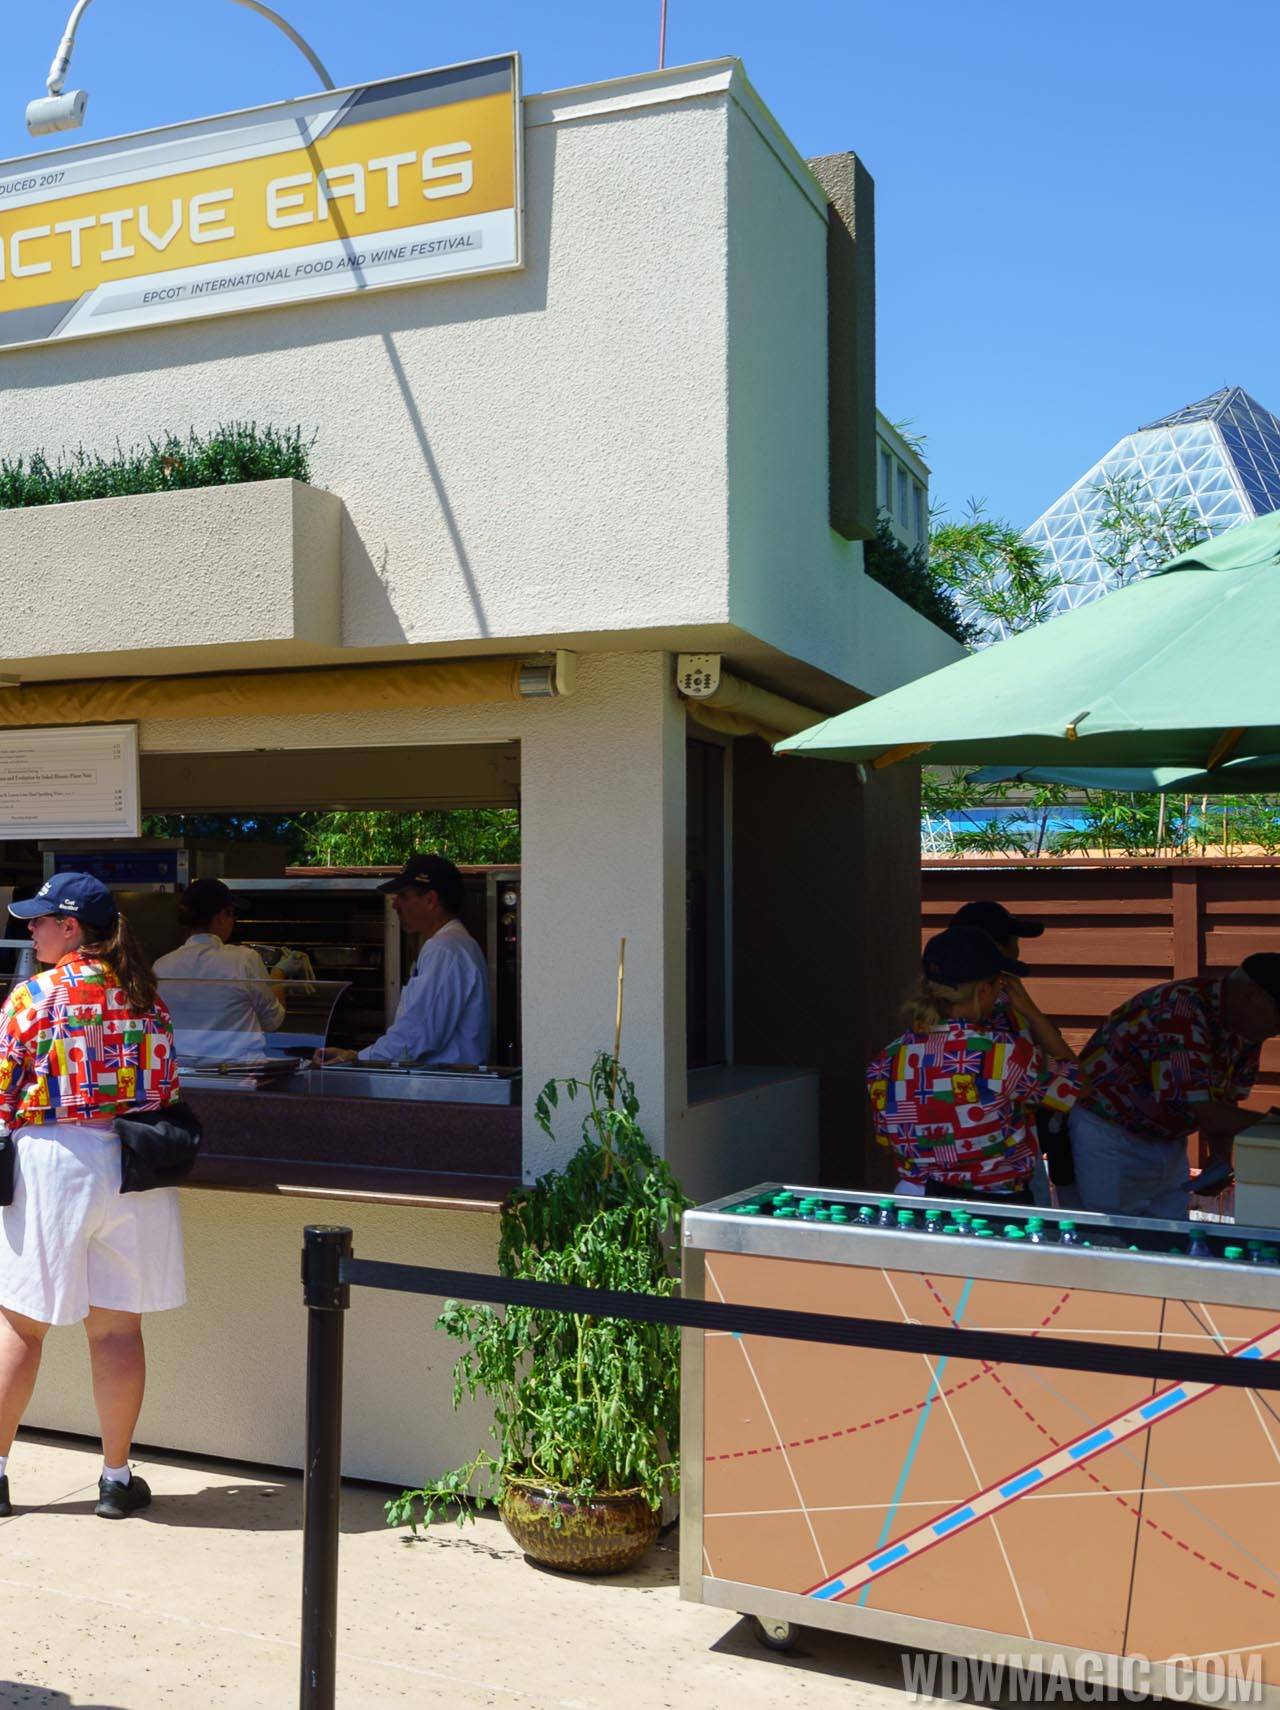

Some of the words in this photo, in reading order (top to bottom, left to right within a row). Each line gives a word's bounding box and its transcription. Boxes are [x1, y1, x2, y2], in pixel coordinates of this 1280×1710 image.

[40, 172, 65, 187] 2017
[266, 141, 473, 229] EATS
[191, 267, 291, 295] INTERNATIONAL
[295, 260, 333, 276] FOOD
[337, 255, 365, 270] AND
[371, 247, 406, 263] WINE
[410, 235, 474, 256] FESTIVAL
